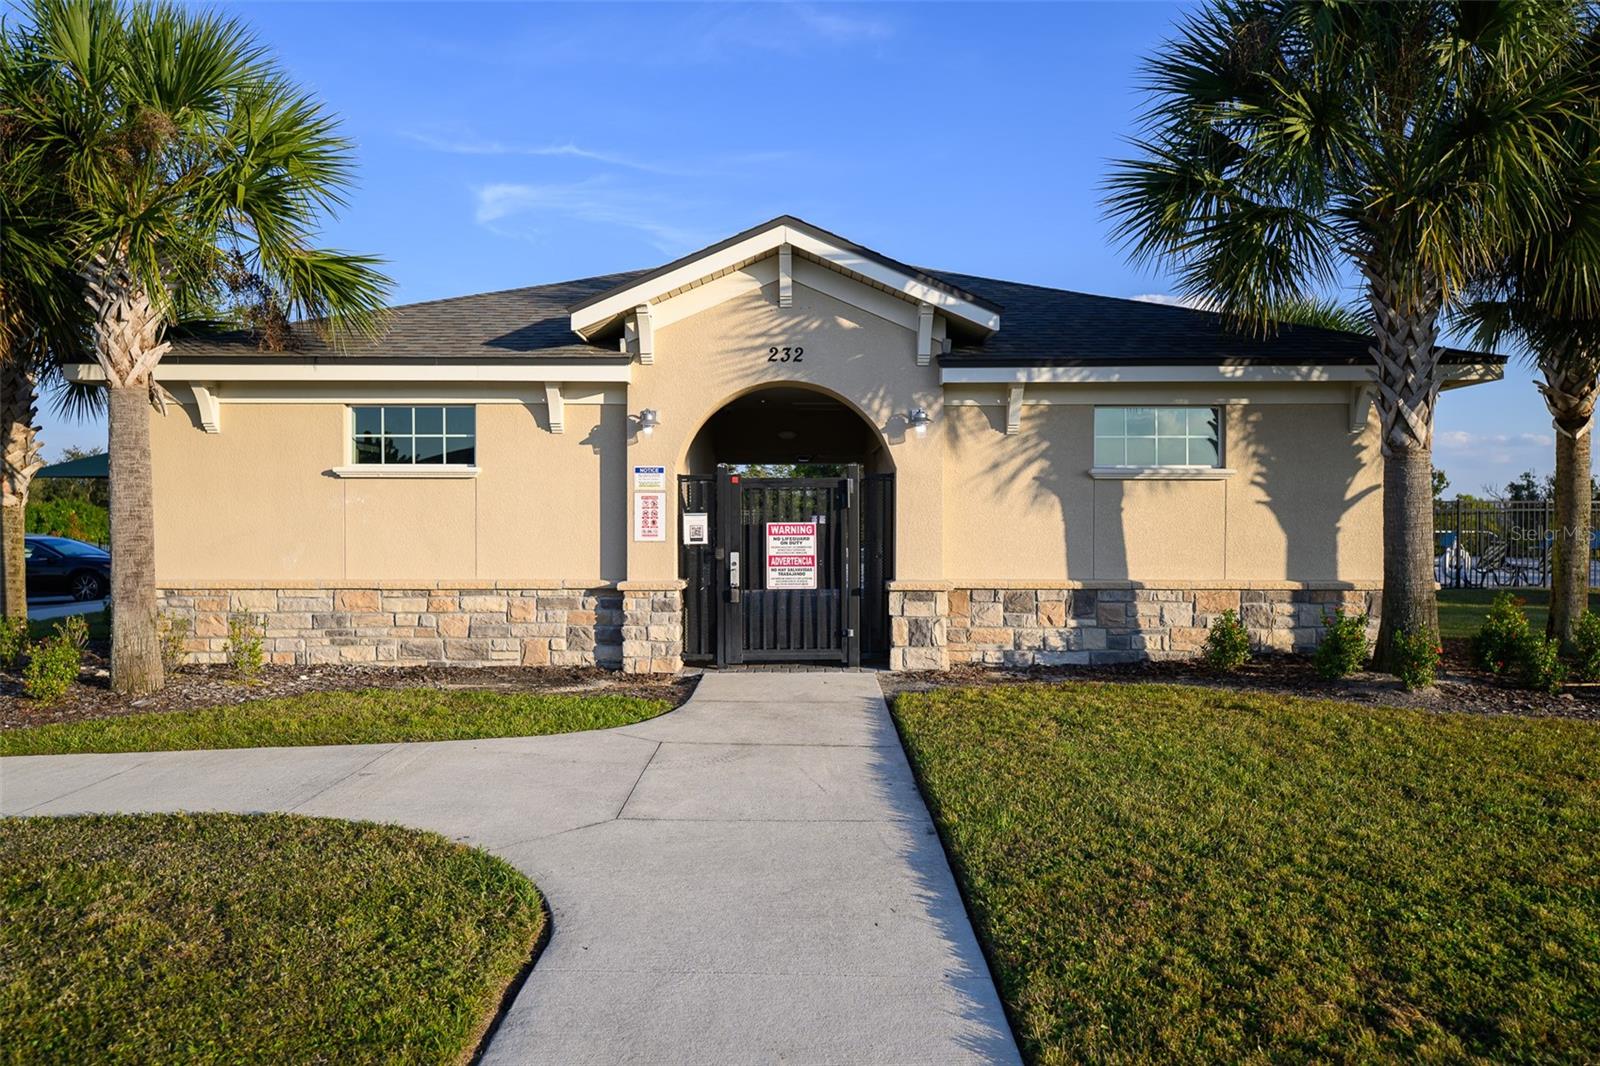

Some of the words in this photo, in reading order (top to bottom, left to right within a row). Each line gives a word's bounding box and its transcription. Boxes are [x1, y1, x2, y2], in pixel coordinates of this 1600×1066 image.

[767, 346, 804, 363] 232
[770, 525, 813, 535] WARNING
[771, 556, 813, 566] ADVERTENCIA
